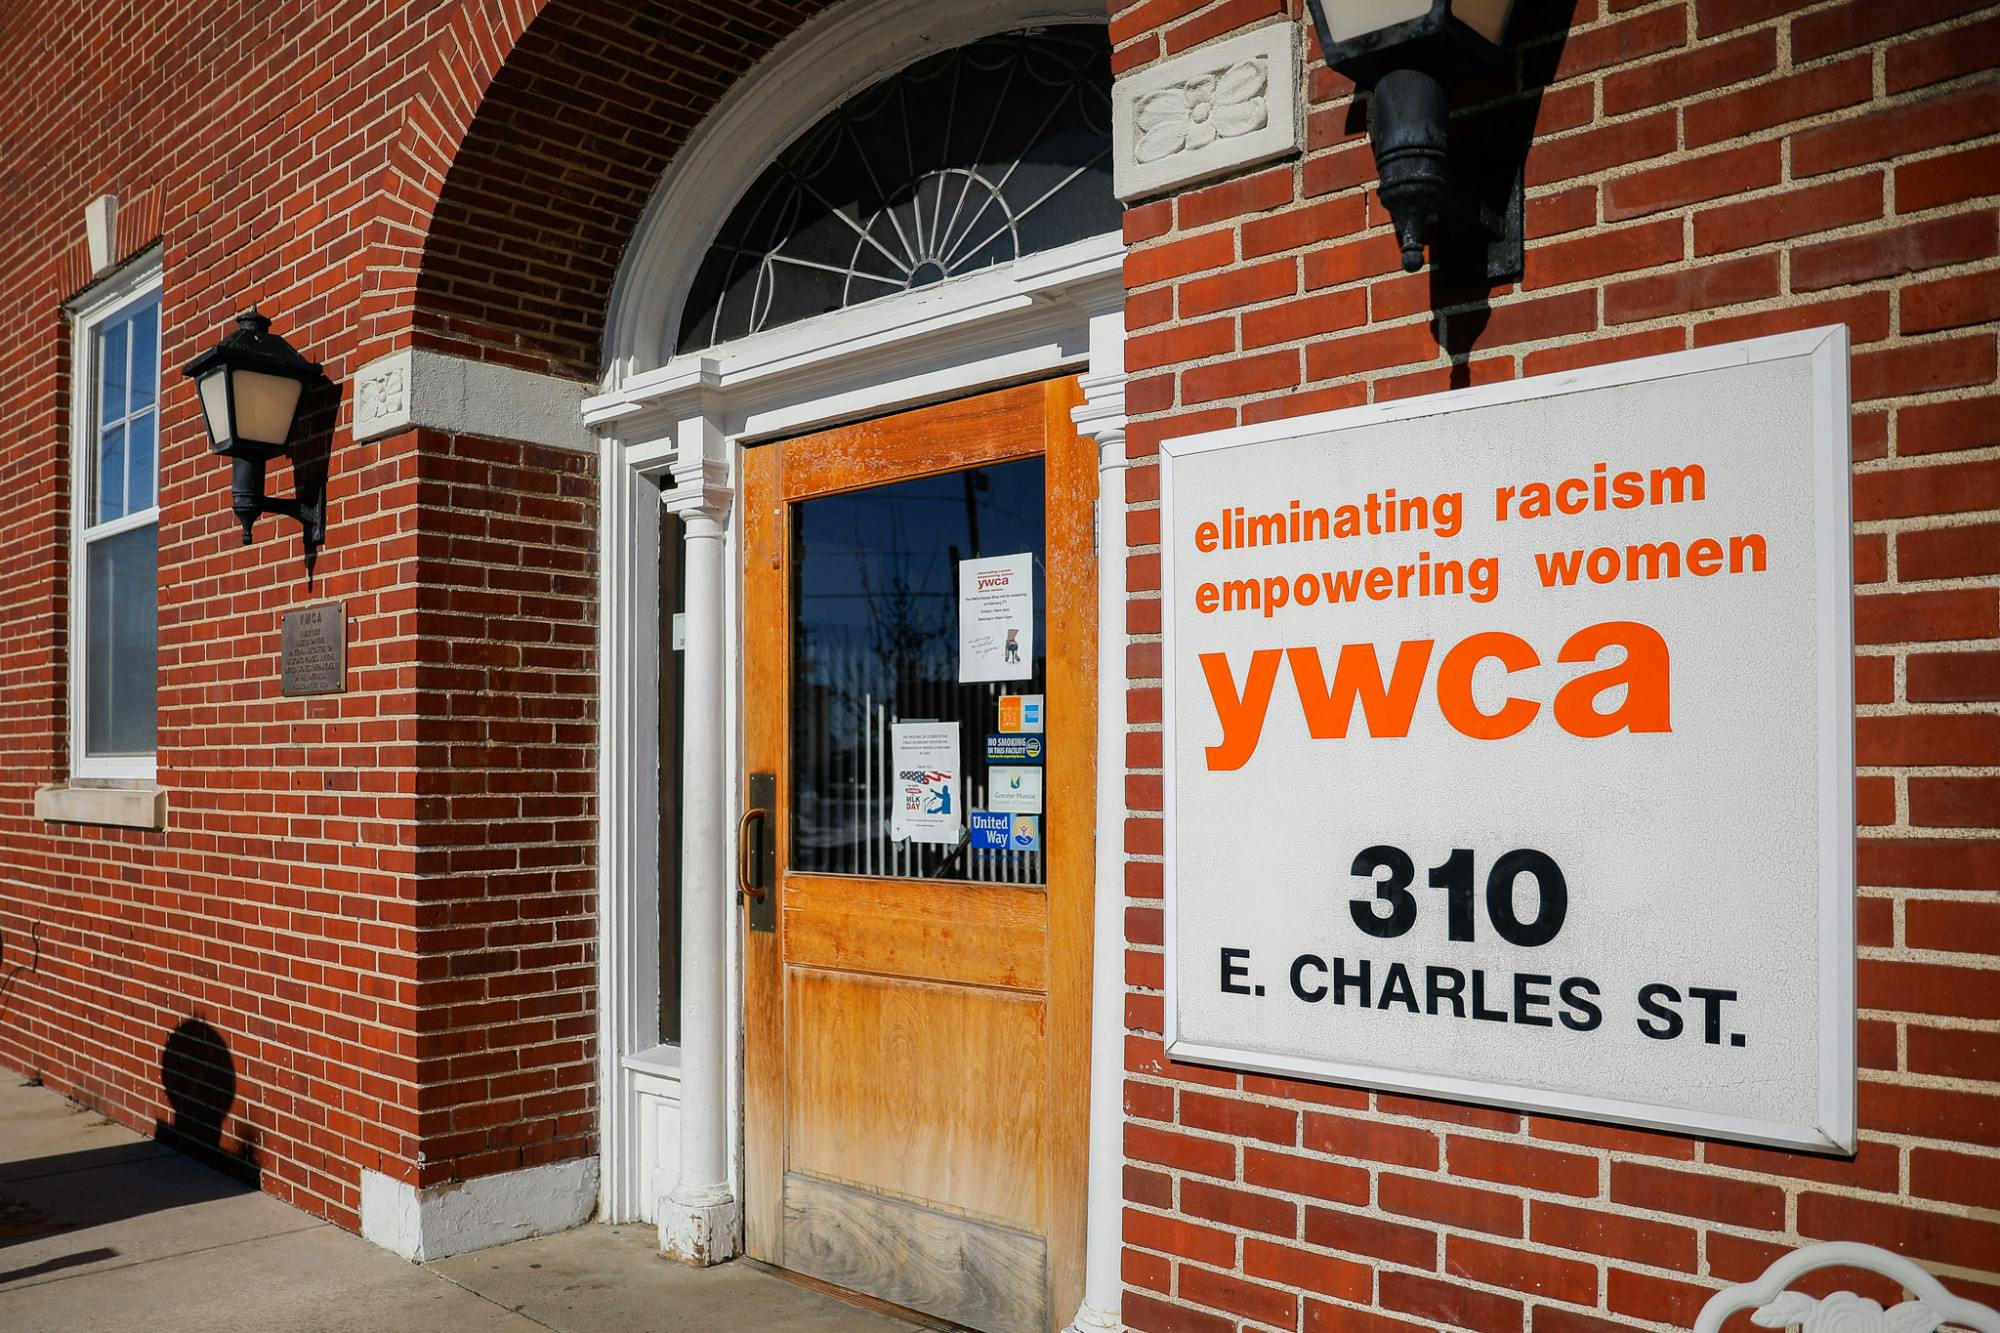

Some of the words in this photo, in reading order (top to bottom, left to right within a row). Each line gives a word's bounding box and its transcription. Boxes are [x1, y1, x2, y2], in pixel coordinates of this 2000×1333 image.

[1195, 489, 1463, 553] eliminating
[1495, 463, 1706, 522] racism
[978, 577, 1009, 589] ywca
[1195, 549, 1500, 618] empowering
[1535, 534, 1768, 588] women
[300, 612, 322, 624] YWCA
[1199, 620, 1673, 772] ywca
[987, 737, 997, 746] NO
[997, 737, 1026, 747] SMOKING
[973, 816, 1008, 829] United
[986, 830, 1008, 847] Way
[1349, 844, 1568, 948] 310
[1221, 947, 1266, 997] E.
[1289, 953, 1603, 1032] CHARLES
[1637, 983, 1746, 1048] ST.
